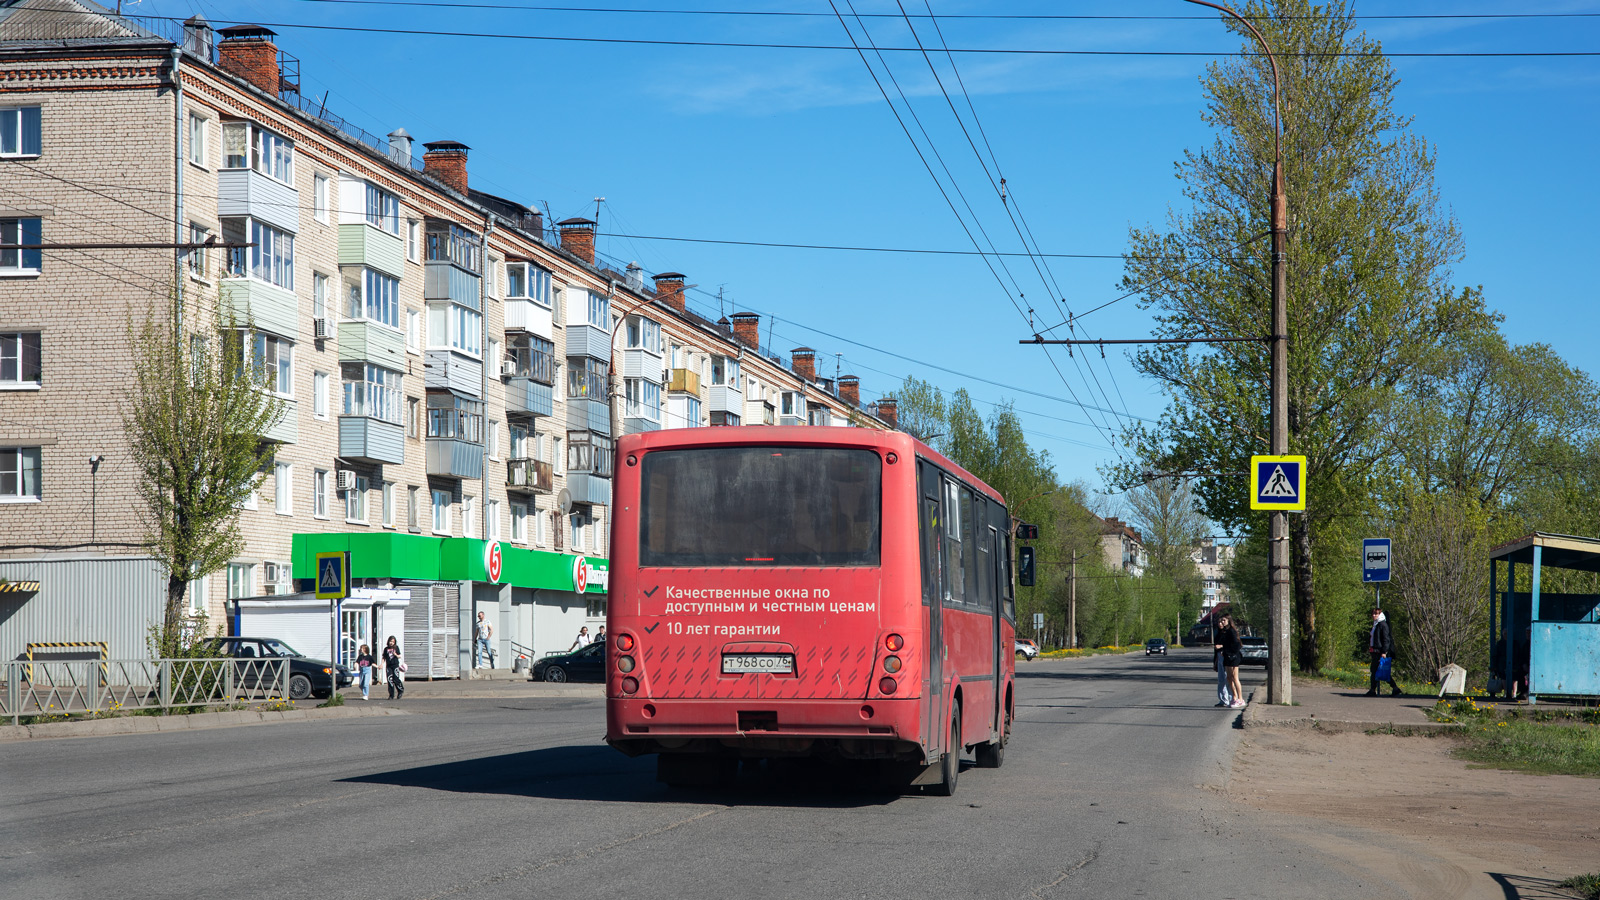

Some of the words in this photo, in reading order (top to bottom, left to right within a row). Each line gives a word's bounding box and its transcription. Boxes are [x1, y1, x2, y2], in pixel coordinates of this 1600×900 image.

[666, 586, 771, 599] Качественные
[775, 588, 809, 598] окна
[813, 588, 830, 598] по
[665, 602, 745, 615] доступным
[749, 602, 758, 612] и
[762, 602, 825, 612] честным
[830, 602, 875, 614] ценам
[667, 622, 682, 635] 10
[686, 625, 710, 635] лет
[714, 625, 780, 638] гарантии
